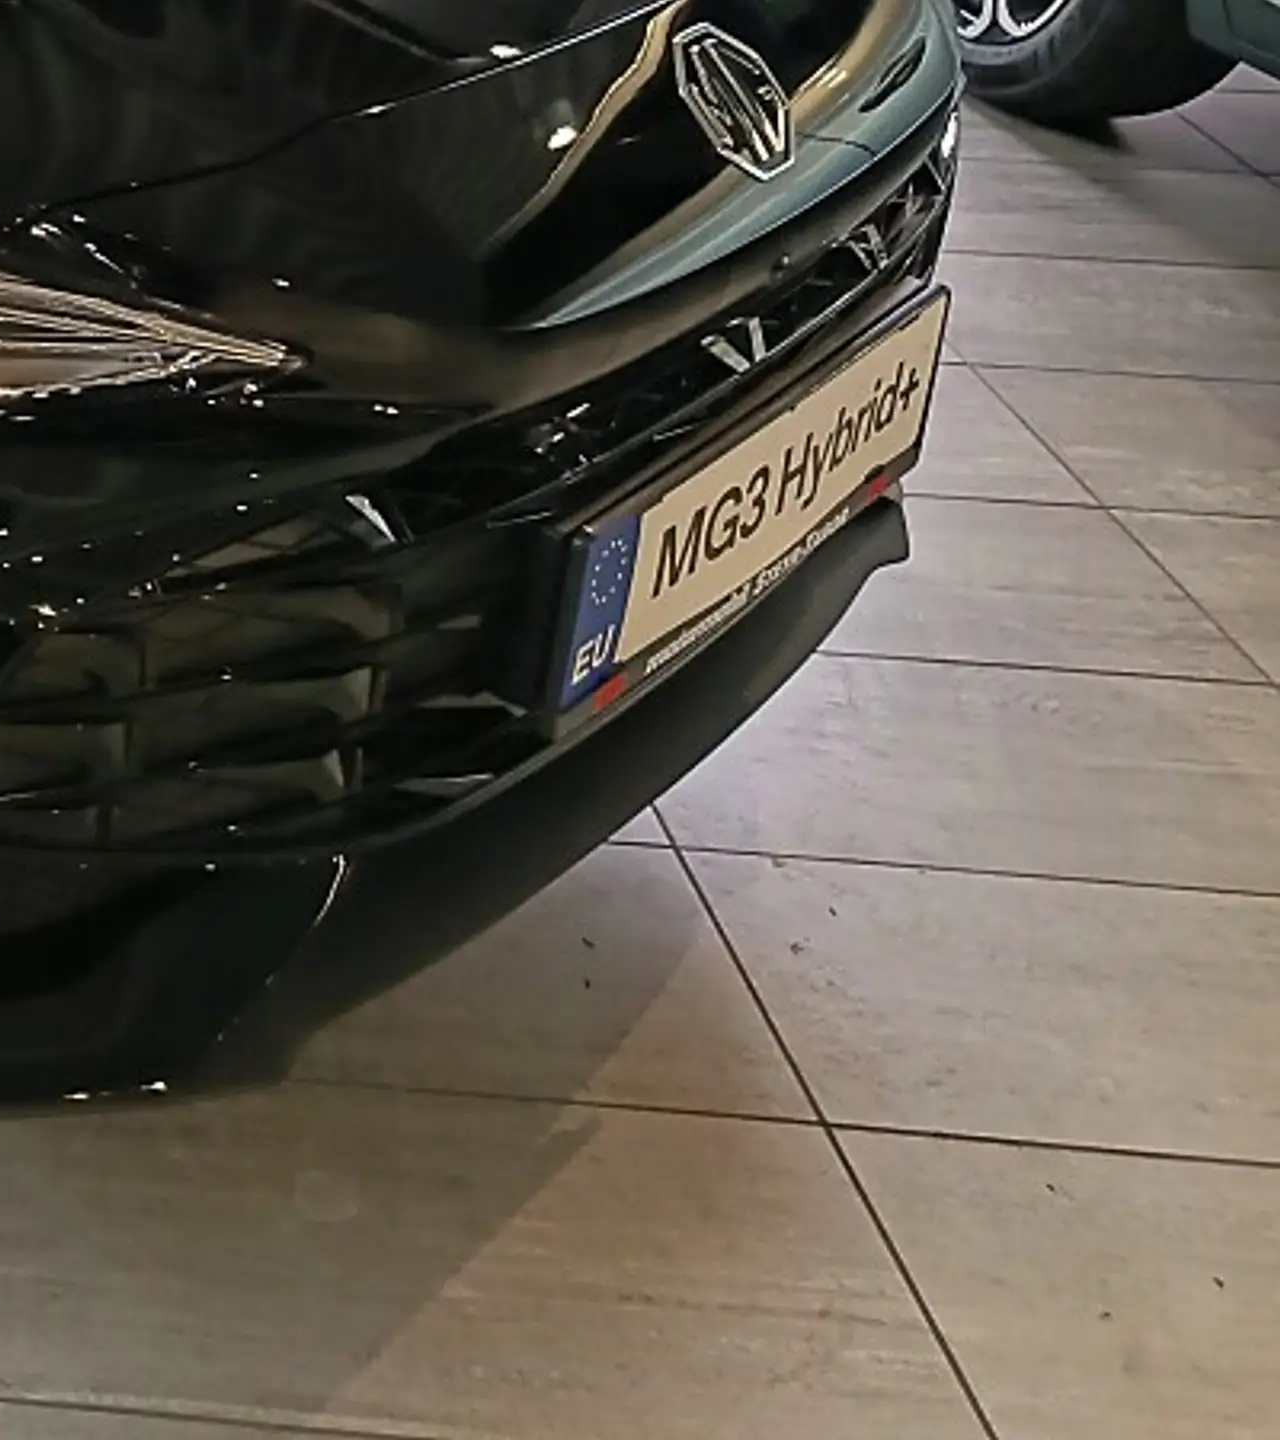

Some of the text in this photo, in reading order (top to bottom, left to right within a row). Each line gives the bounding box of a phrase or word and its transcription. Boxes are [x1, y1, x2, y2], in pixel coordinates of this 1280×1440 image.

[688, 37, 787, 162] MG
[650, 466, 770, 600] MG3
[775, 361, 921, 517] Hybrid+
[571, 625, 617, 686] EU
